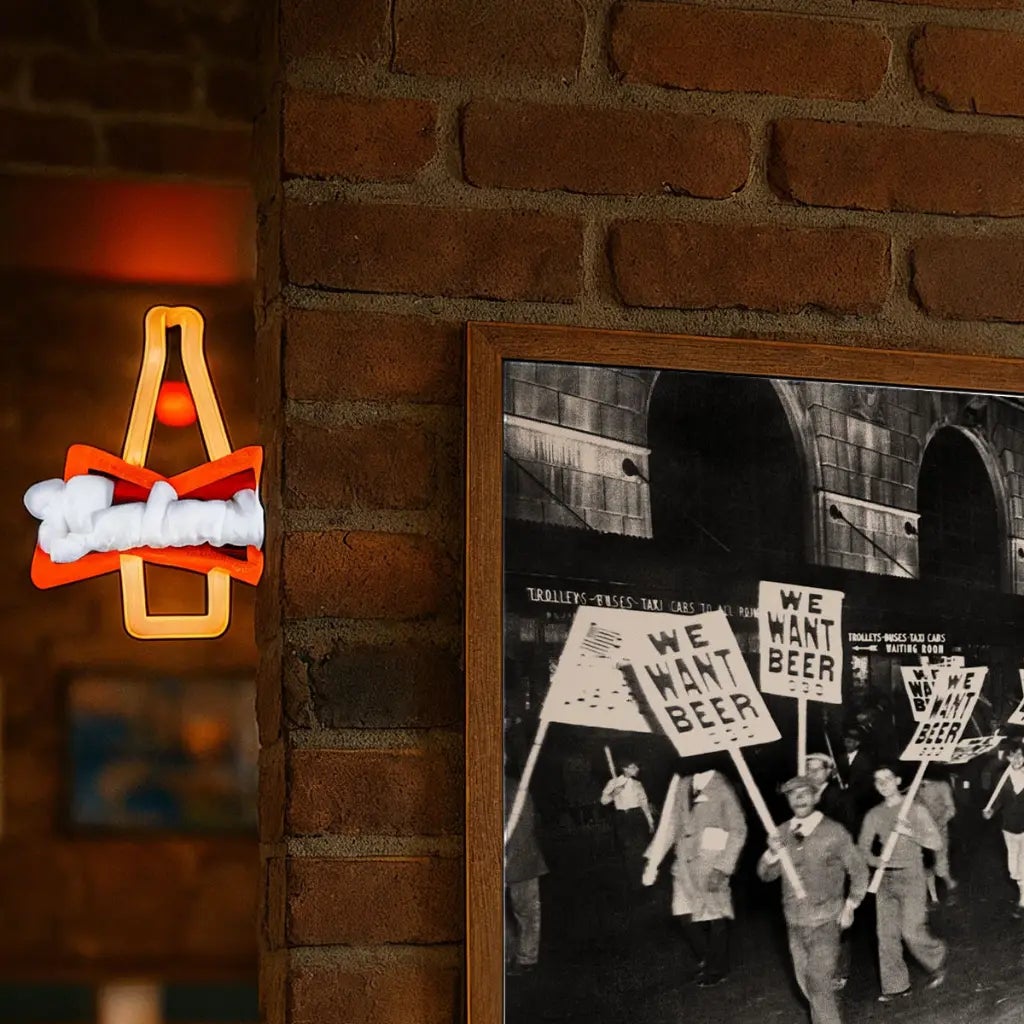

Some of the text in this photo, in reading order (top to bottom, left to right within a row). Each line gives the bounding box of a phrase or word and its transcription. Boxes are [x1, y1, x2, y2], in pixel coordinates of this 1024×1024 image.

[671, 600, 695, 614] CABS
[780, 588, 823, 615] WE
[647, 623, 710, 656] WE
[767, 610, 835, 652] WANT
[927, 633, 946, 643] CABS
[886, 644, 944, 654] WAITING ROOM
[644, 649, 738, 701] WANT
[768, 647, 836, 682] BEER
[948, 672, 976, 690] WE
[664, 693, 760, 734] BEER
[930, 691, 976, 720] WANT
[915, 722, 962, 745] BEER
